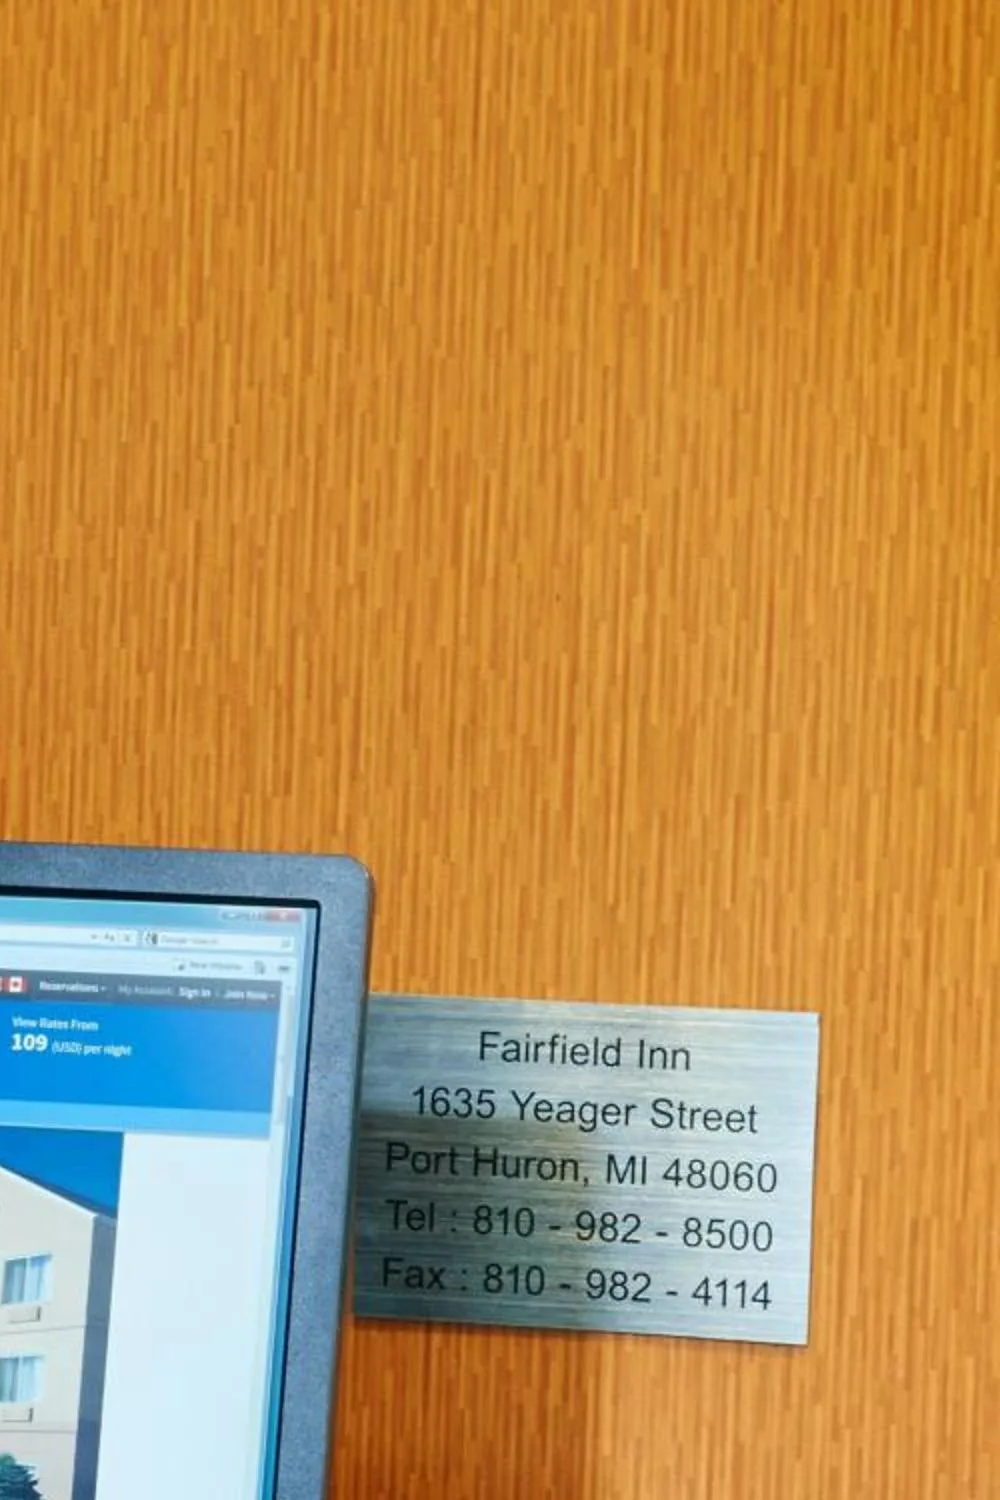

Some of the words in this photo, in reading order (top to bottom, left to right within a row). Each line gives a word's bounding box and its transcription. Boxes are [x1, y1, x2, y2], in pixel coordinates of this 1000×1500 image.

[10, 1033, 48, 1052] 109
[83, 1044, 103, 1057] per
[103, 1044, 132, 1058] night
[70, 1018, 99, 1031] From
[479, 1030, 622, 1068] Fairfield
[637, 1039, 691, 1071] Inn
[412, 1085, 496, 1120] 1635
[511, 1090, 636, 1133] Yeager
[650, 1097, 758, 1134] Street
[385, 1141, 459, 1176] Port
[473, 1146, 590, 1188] Huron,
[606, 1154, 647, 1186] MI
[662, 1158, 778, 1194] 48060
[386, 1199, 435, 1232] Tel
[472, 1204, 535, 1238] 810
[575, 1210, 642, 1245] 982
[682, 1217, 773, 1252] 8500
[382, 1257, 447, 1292] Fax
[483, 1263, 546, 1297] 810
[585, 1268, 652, 1303] 982
[691, 1277, 773, 1310] 4114
